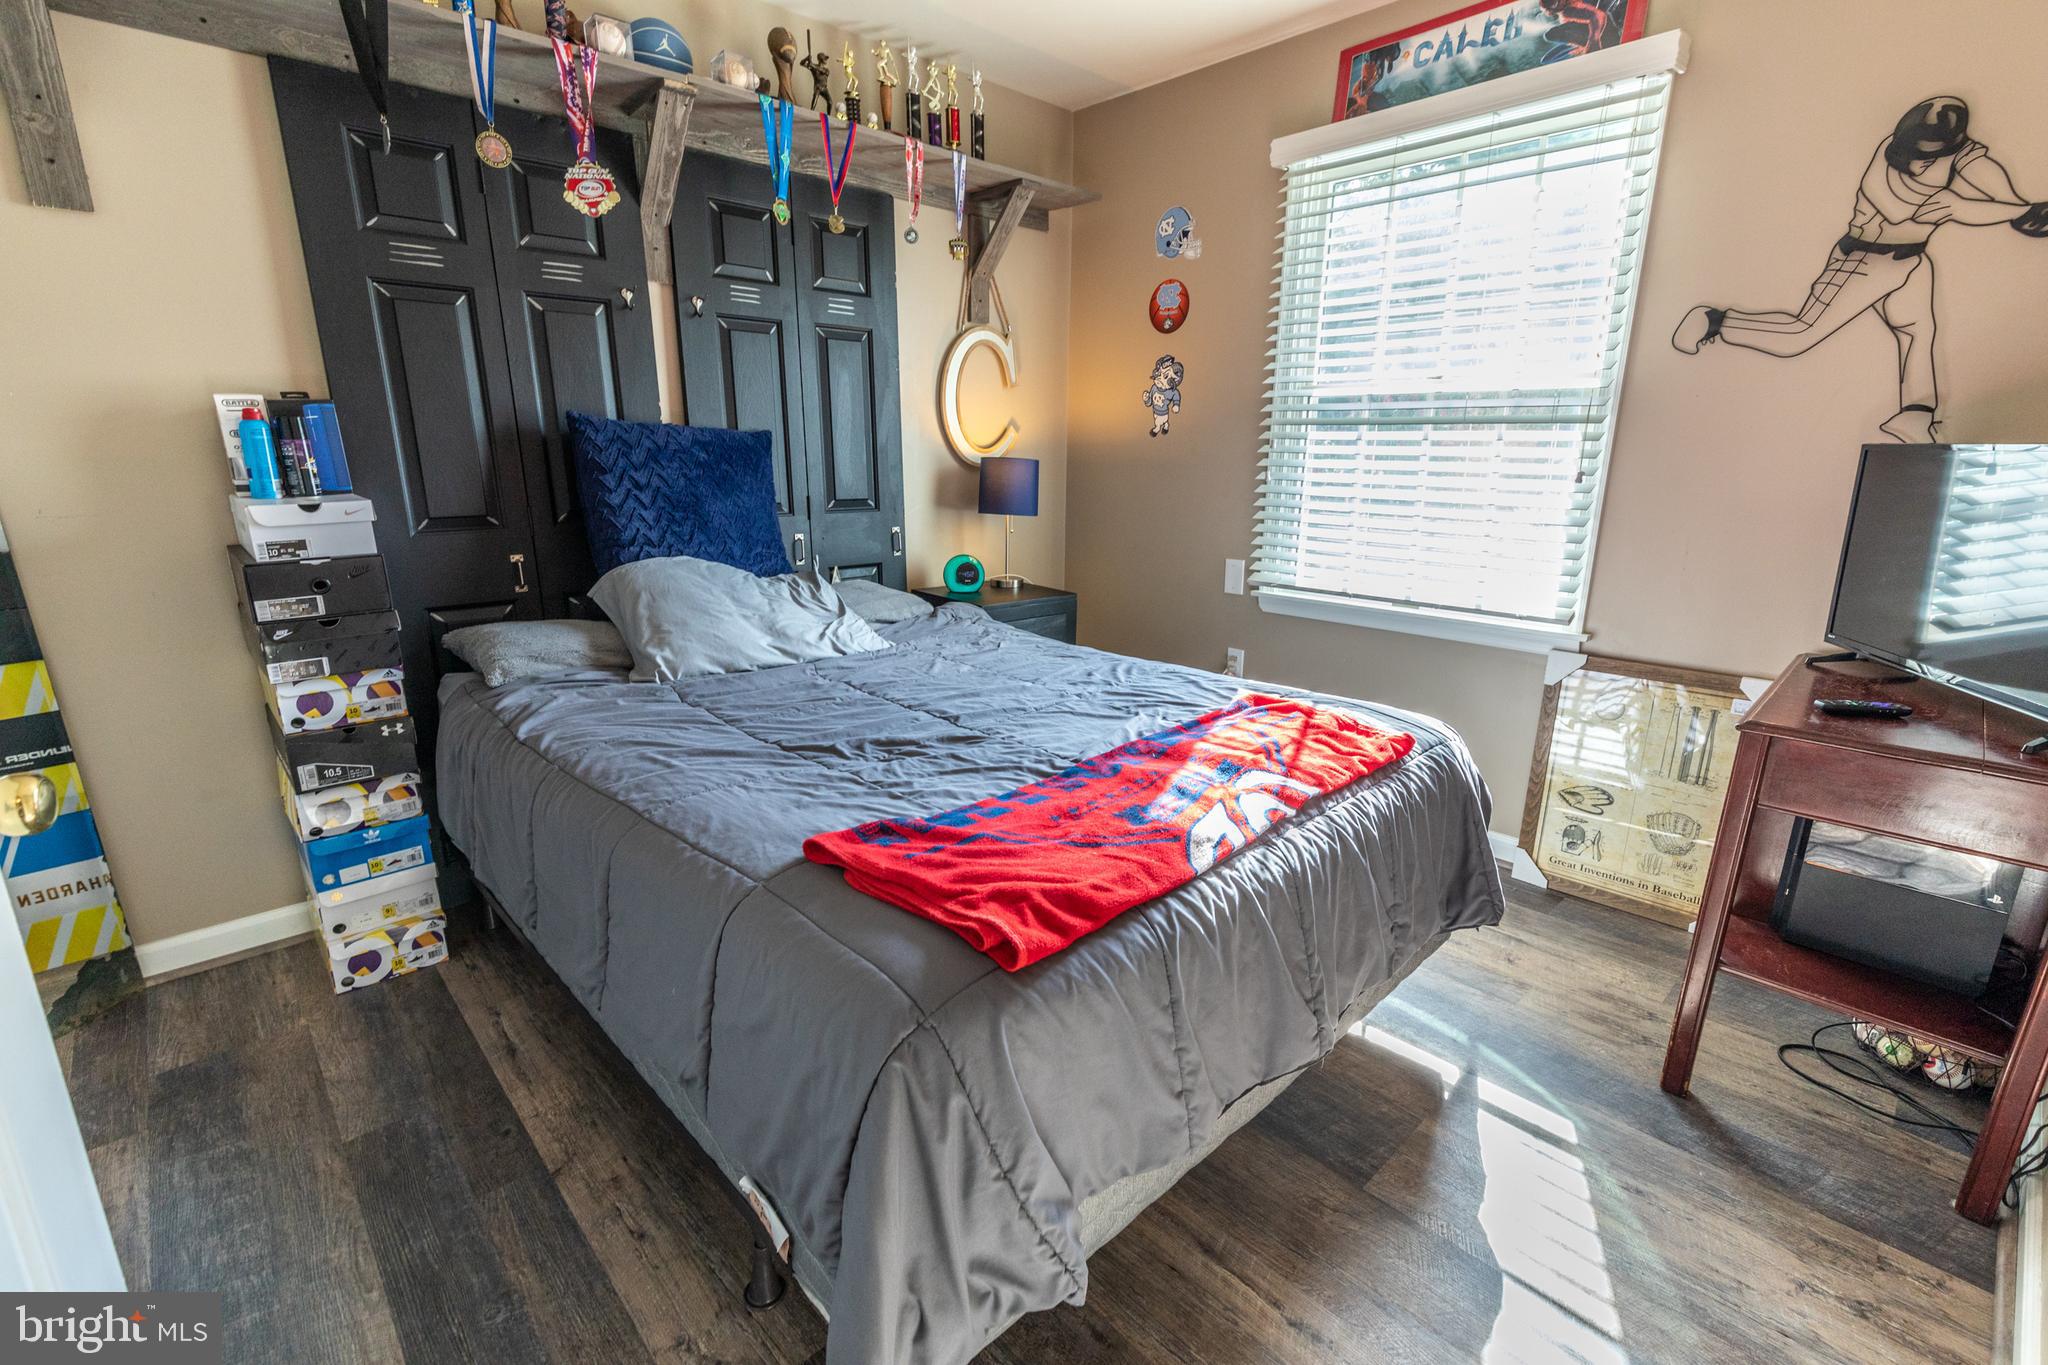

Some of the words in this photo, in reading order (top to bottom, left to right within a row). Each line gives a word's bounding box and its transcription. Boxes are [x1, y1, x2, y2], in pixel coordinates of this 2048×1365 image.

[225, 399, 257, 407] BATTLE
[268, 549, 278, 558] 10
[349, 707, 358, 715] 10
[323, 767, 342, 779] 10.5
[1549, 855, 1577, 870] Great
[1580, 864, 1636, 886] Inventions
[1637, 880, 1650, 891] in
[1652, 884, 1702, 906] Baseball
[394, 959, 403, 967] 10
